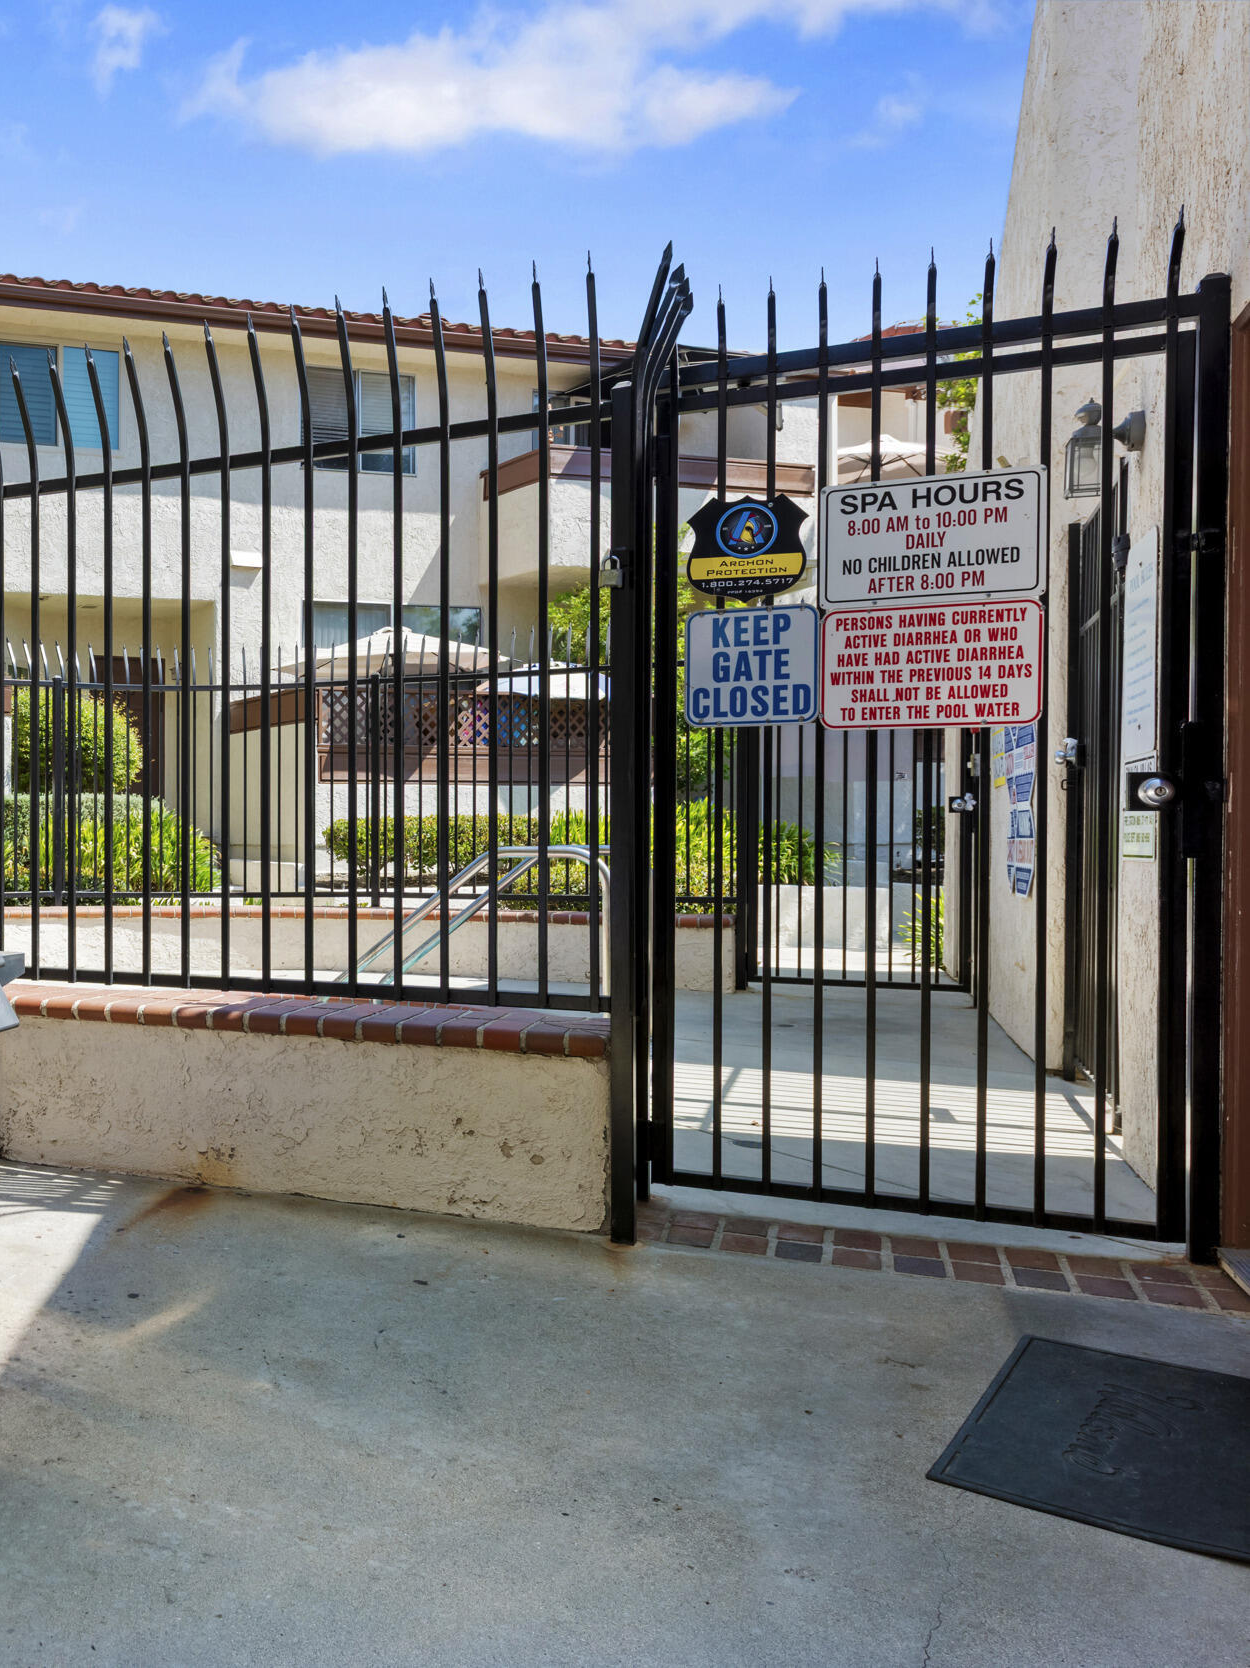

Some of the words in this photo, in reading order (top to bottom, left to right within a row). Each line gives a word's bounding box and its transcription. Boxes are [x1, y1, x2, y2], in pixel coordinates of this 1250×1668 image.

[840, 491, 898, 515] SPA
[912, 478, 1024, 509] HOURS
[847, 518, 880, 536] 8:00
[885, 515, 909, 533] AM
[915, 515, 930, 530] to
[936, 509, 977, 528] 10:00
[984, 506, 1008, 524] PM
[905, 531, 946, 550] DAILY
[706, 567, 787, 577] PROTECTION
[719, 559, 774, 568] ARCHON
[842, 558, 862, 575] NO
[868, 552, 941, 574] CHILDREN
[947, 546, 1020, 568] ALLOWED
[701, 578, 794, 588] 1.800.274.5717
[867, 575, 915, 594] AFTER
[920, 572, 954, 590] 8:00
[961, 570, 985, 587] PM
[712, 613, 791, 648] KEEP
[835, 615, 893, 632] PERSONS
[899, 612, 946, 629] HAVING
[952, 607, 1028, 625] CURRENTLY
[844, 633, 887, 649] ACTIVE
[893, 630, 958, 647] DIARRHEA
[964, 628, 981, 643] OR
[988, 626, 1018, 642] WHO
[712, 648, 790, 683] GATE
[837, 653, 869, 667] HAVE
[874, 651, 900, 666] HAD
[905, 649, 951, 665] ACTIVE
[957, 645, 1025, 662] DIARRHEA
[830, 670, 874, 686] WITHIN
[880, 669, 903, 684] THE
[909, 666, 972, 683] PREVIOUS
[978, 665, 992, 680] 14
[998, 663, 1033, 679] DAYS
[692, 683, 811, 719] CLOSED
[851, 688, 890, 703] SHALL
[895, 687, 920, 701] NOT
[926, 686, 941, 700] BE
[947, 683, 1008, 699] ALLOWED
[840, 707, 855, 721] TO
[861, 706, 901, 721] ENTER
[906, 705, 930, 719] THE
[936, 703, 969, 719] POOL
[974, 702, 1020, 717] WATER
